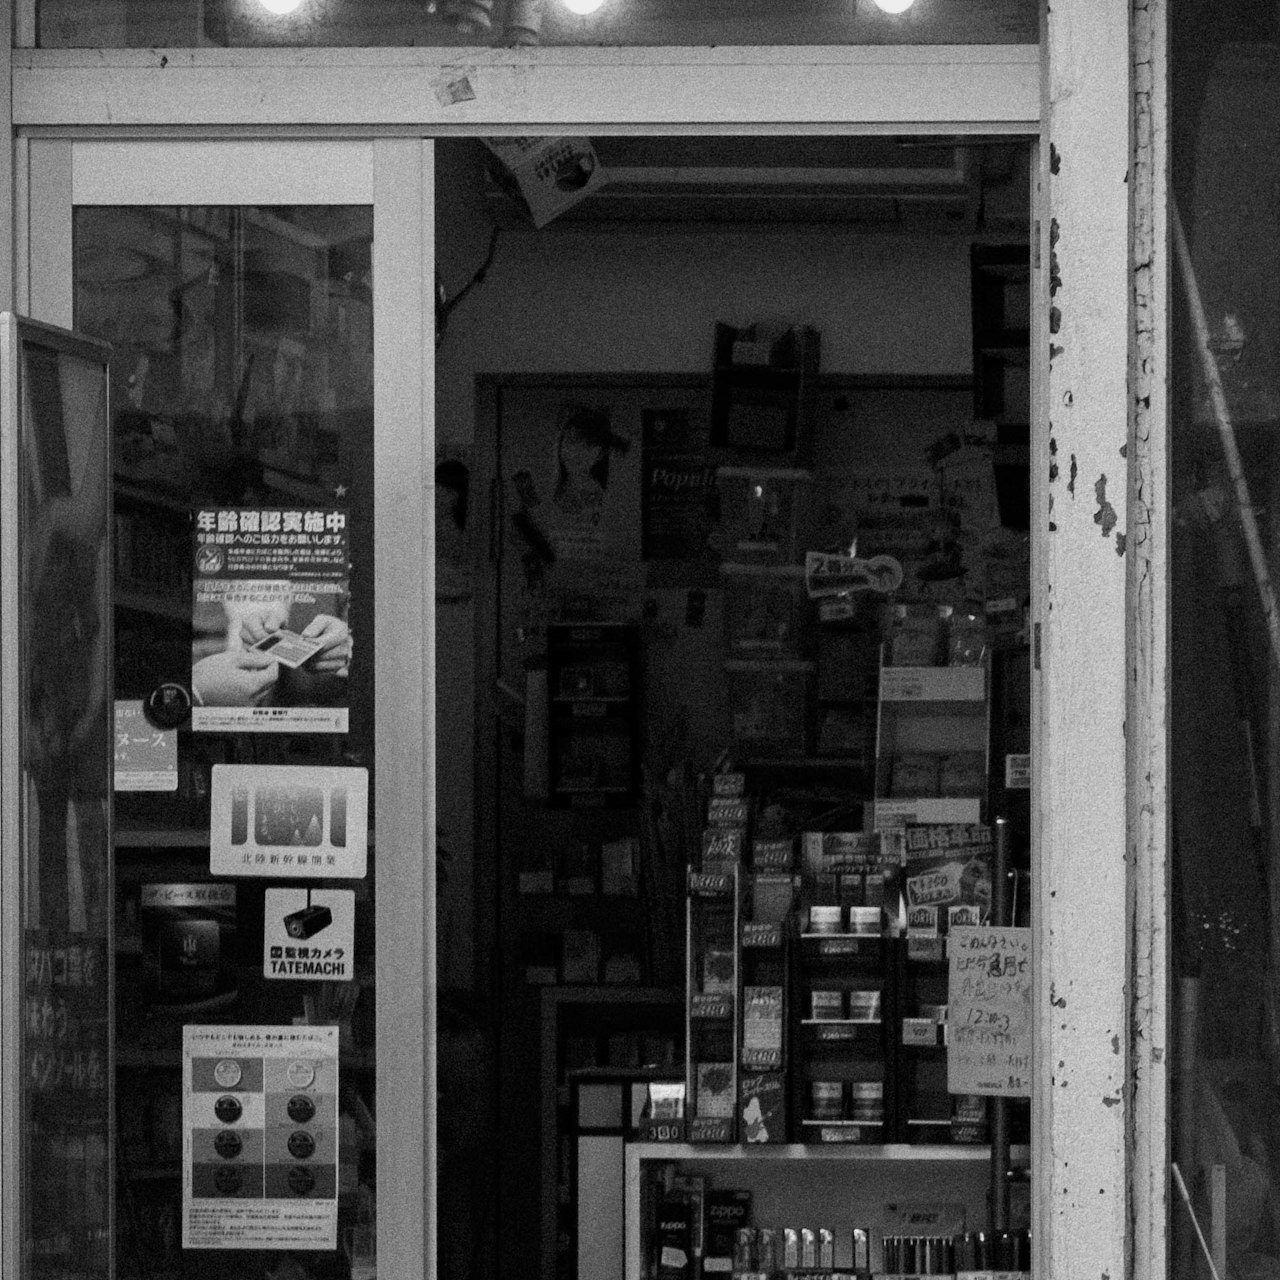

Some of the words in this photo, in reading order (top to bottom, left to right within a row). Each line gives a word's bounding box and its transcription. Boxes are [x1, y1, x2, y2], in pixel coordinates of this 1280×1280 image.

[196, 510, 346, 533] 年齢確認実施中
[270, 960, 345, 975] TATEMACHI
